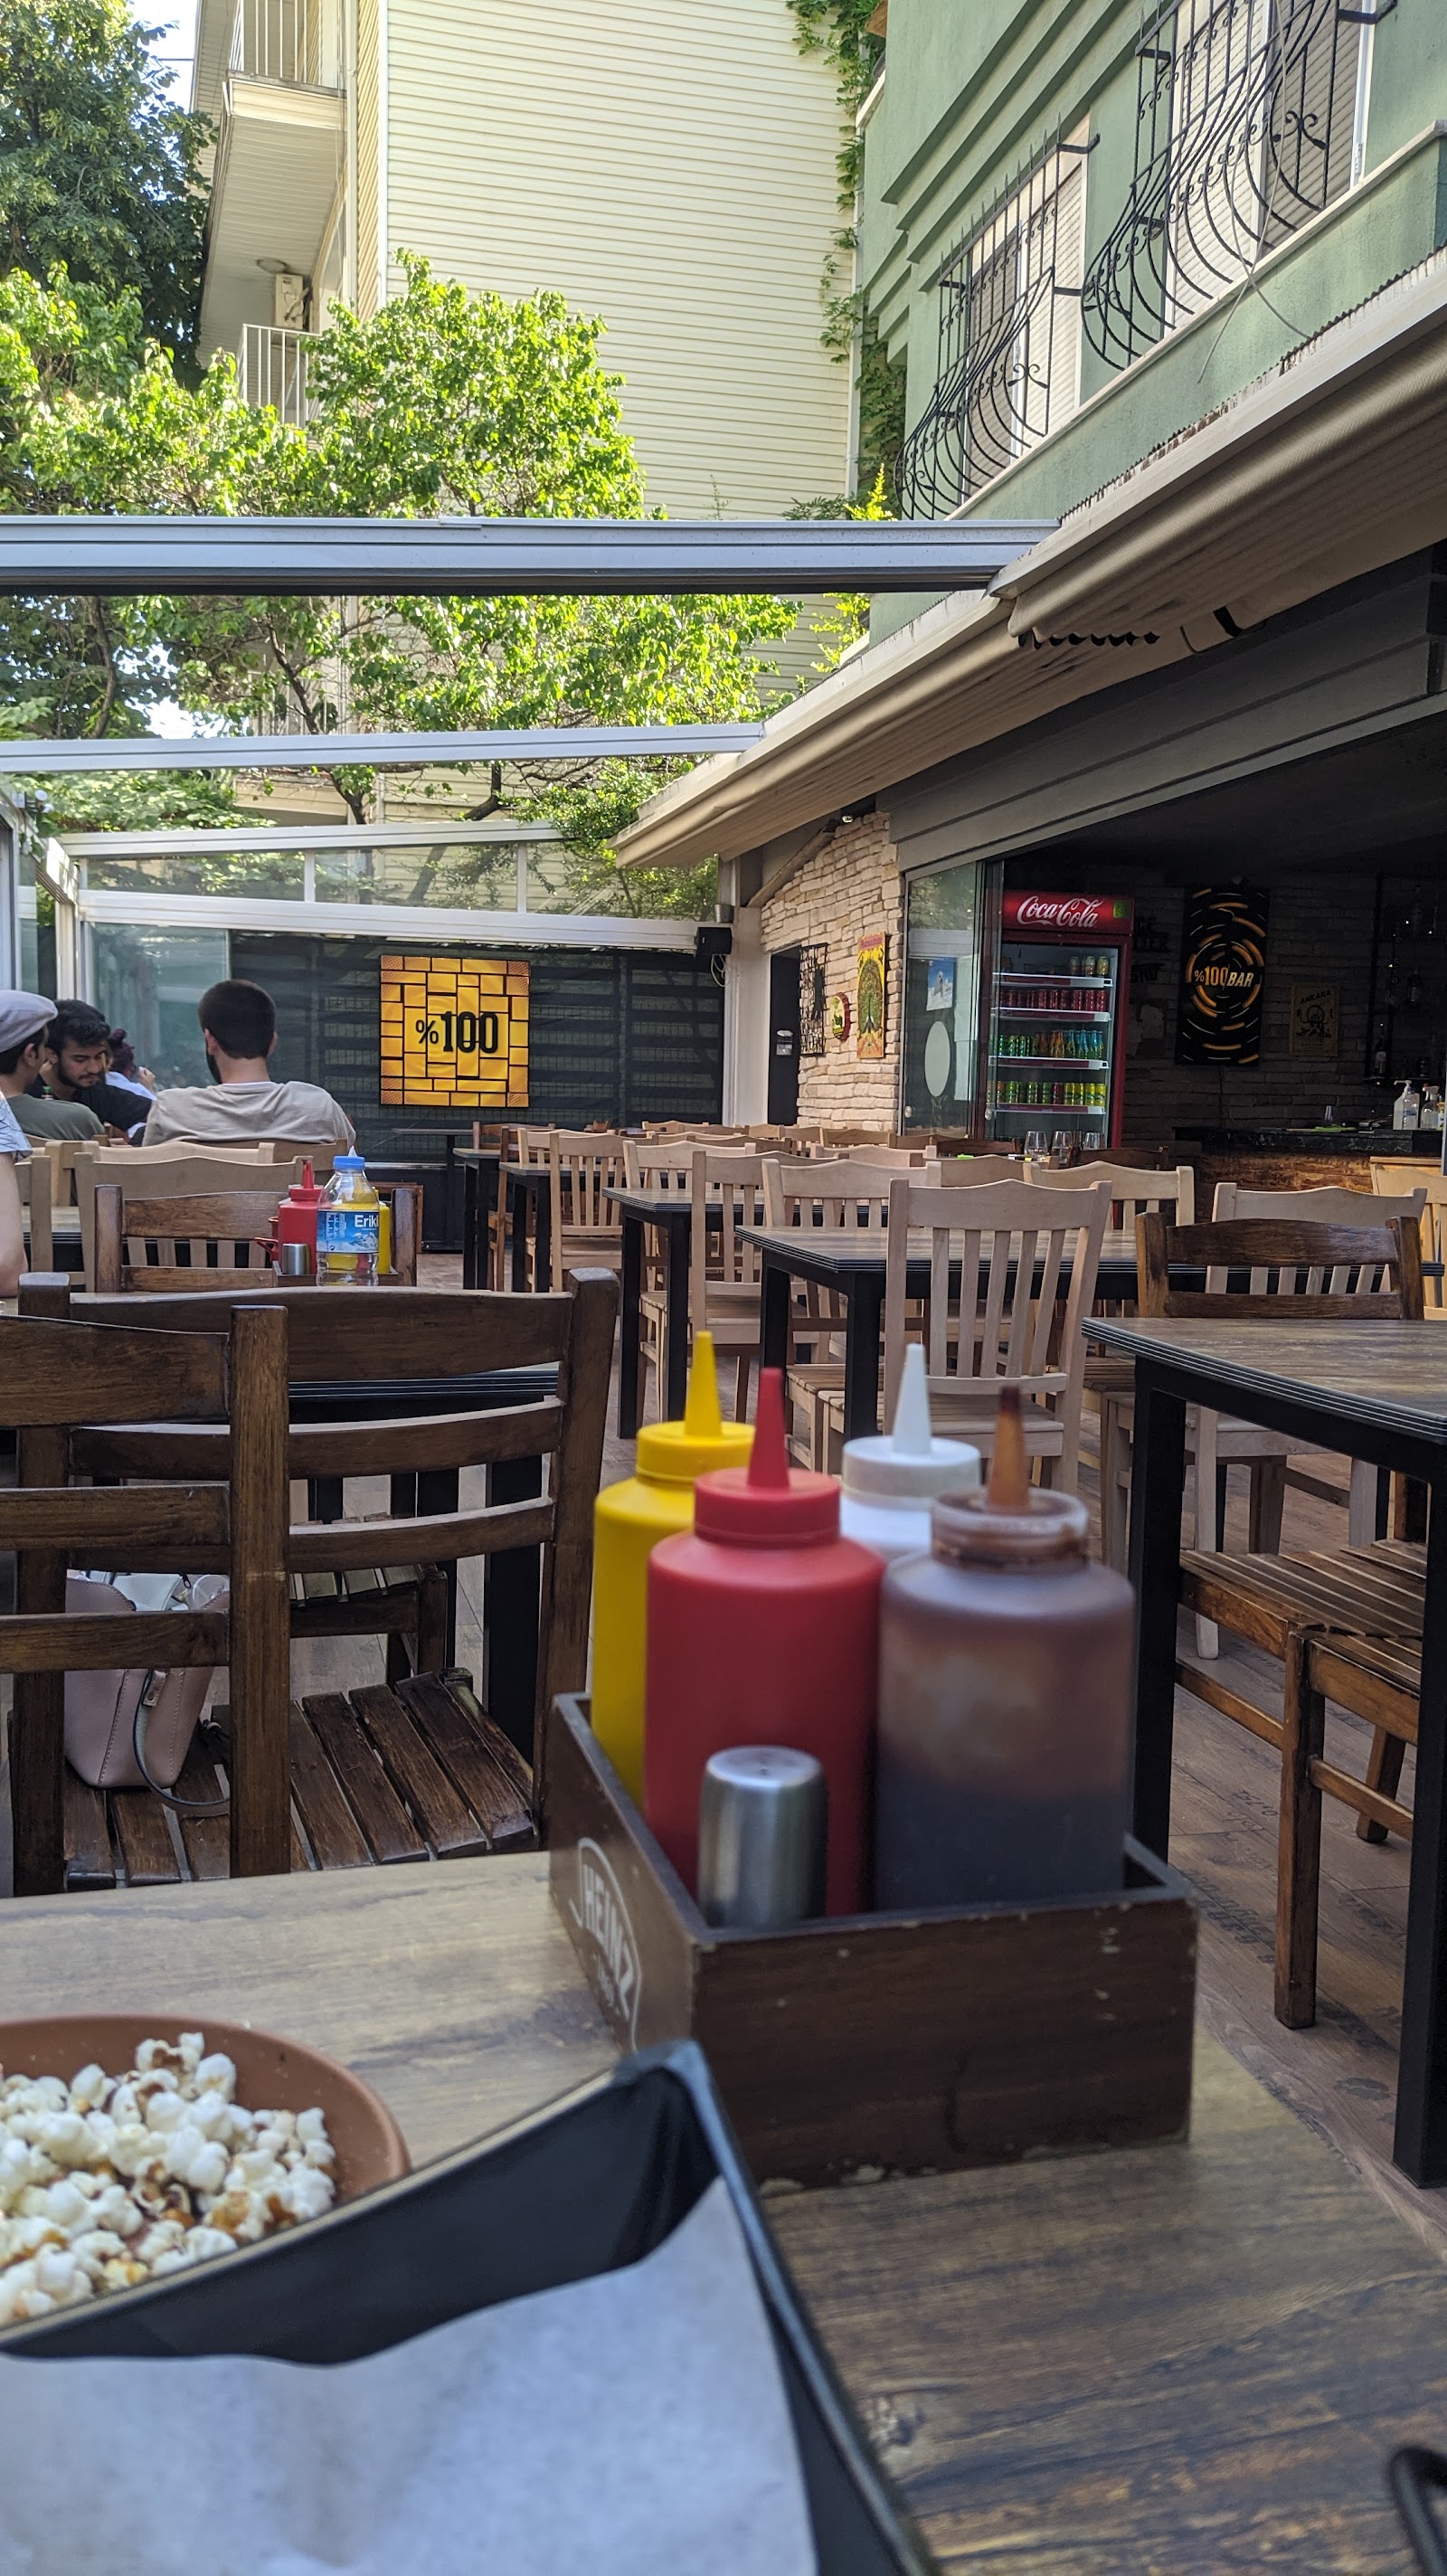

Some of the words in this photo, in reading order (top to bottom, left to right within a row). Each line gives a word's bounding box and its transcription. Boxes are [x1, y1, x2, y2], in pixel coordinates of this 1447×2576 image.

[1017, 895, 1102, 928] Coca-Cola
[415, 1010, 498, 1054] %100
[355, 1214, 379, 1227] Erikl
[582, 1863, 633, 2021] HEINZ
